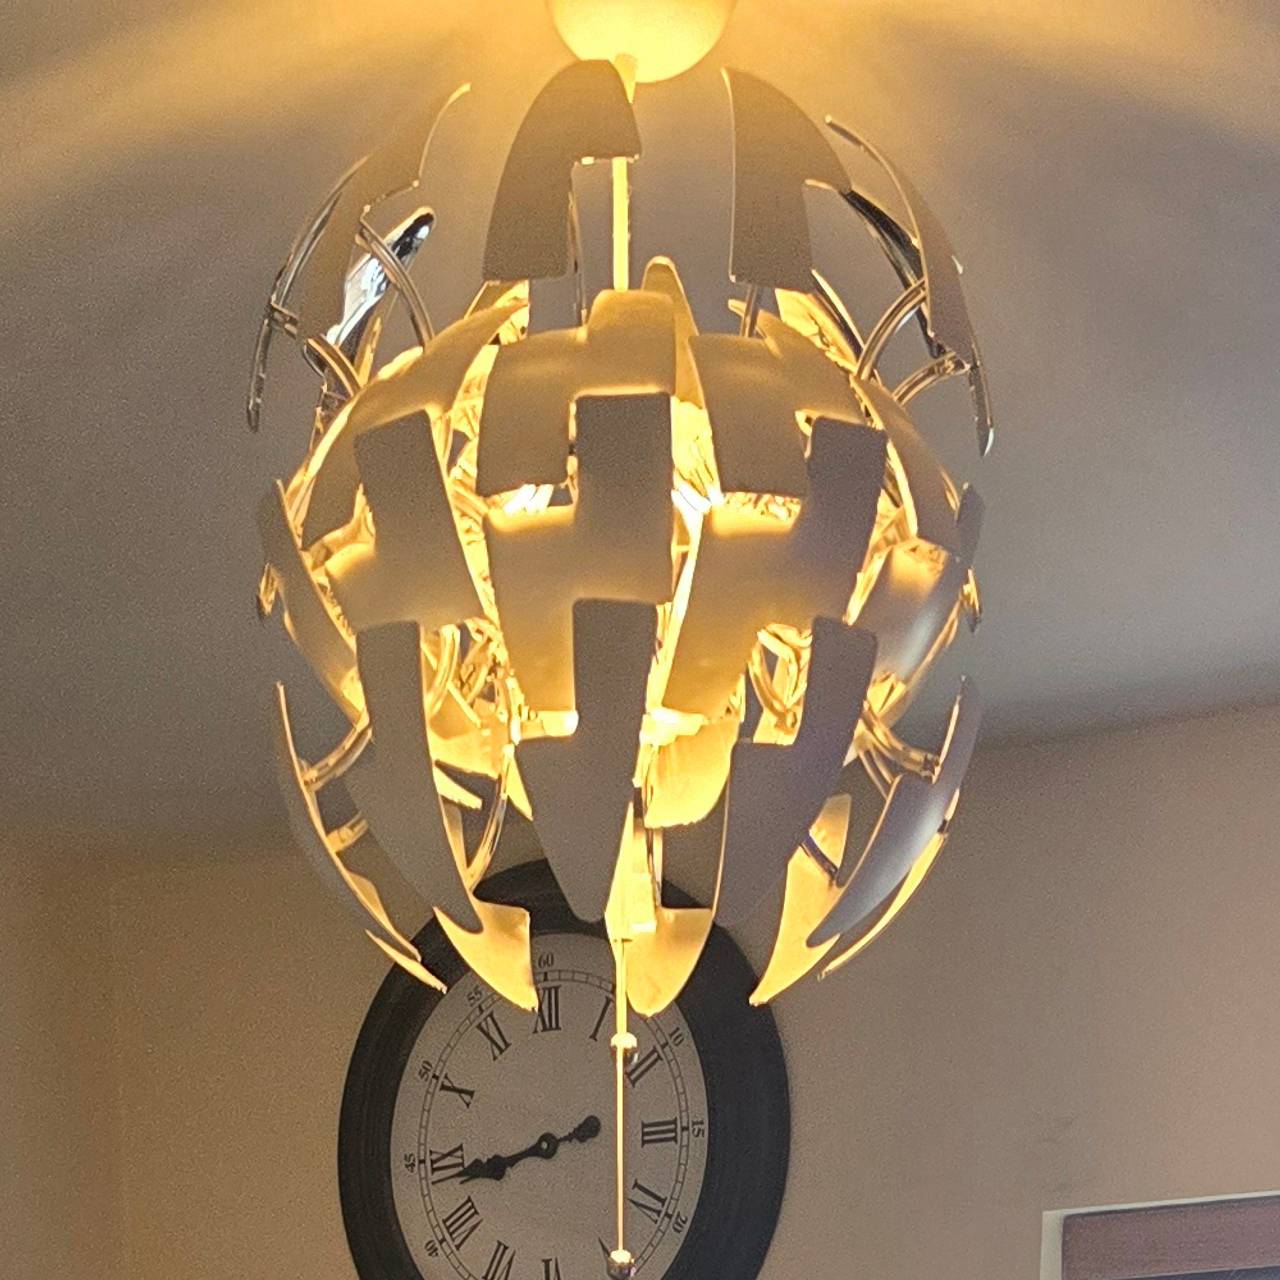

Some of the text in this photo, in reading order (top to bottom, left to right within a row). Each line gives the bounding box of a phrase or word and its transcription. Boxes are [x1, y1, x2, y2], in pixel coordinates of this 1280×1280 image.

[537, 953, 555, 969] 60
[466, 989, 485, 1007] 55
[476, 1011, 513, 1061] XI
[669, 1026, 685, 1047] 10
[418, 1060, 433, 1082] 50
[625, 1046, 664, 1088] II
[439, 1073, 475, 1109] X
[640, 1117, 677, 1148] III
[691, 1120, 705, 1139] 15
[404, 1152, 417, 1174] 45
[628, 1179, 668, 1224] IV
[441, 1195, 484, 1251] VIII
[672, 1211, 688, 1234] 20
[424, 1239, 439, 1258] 40
